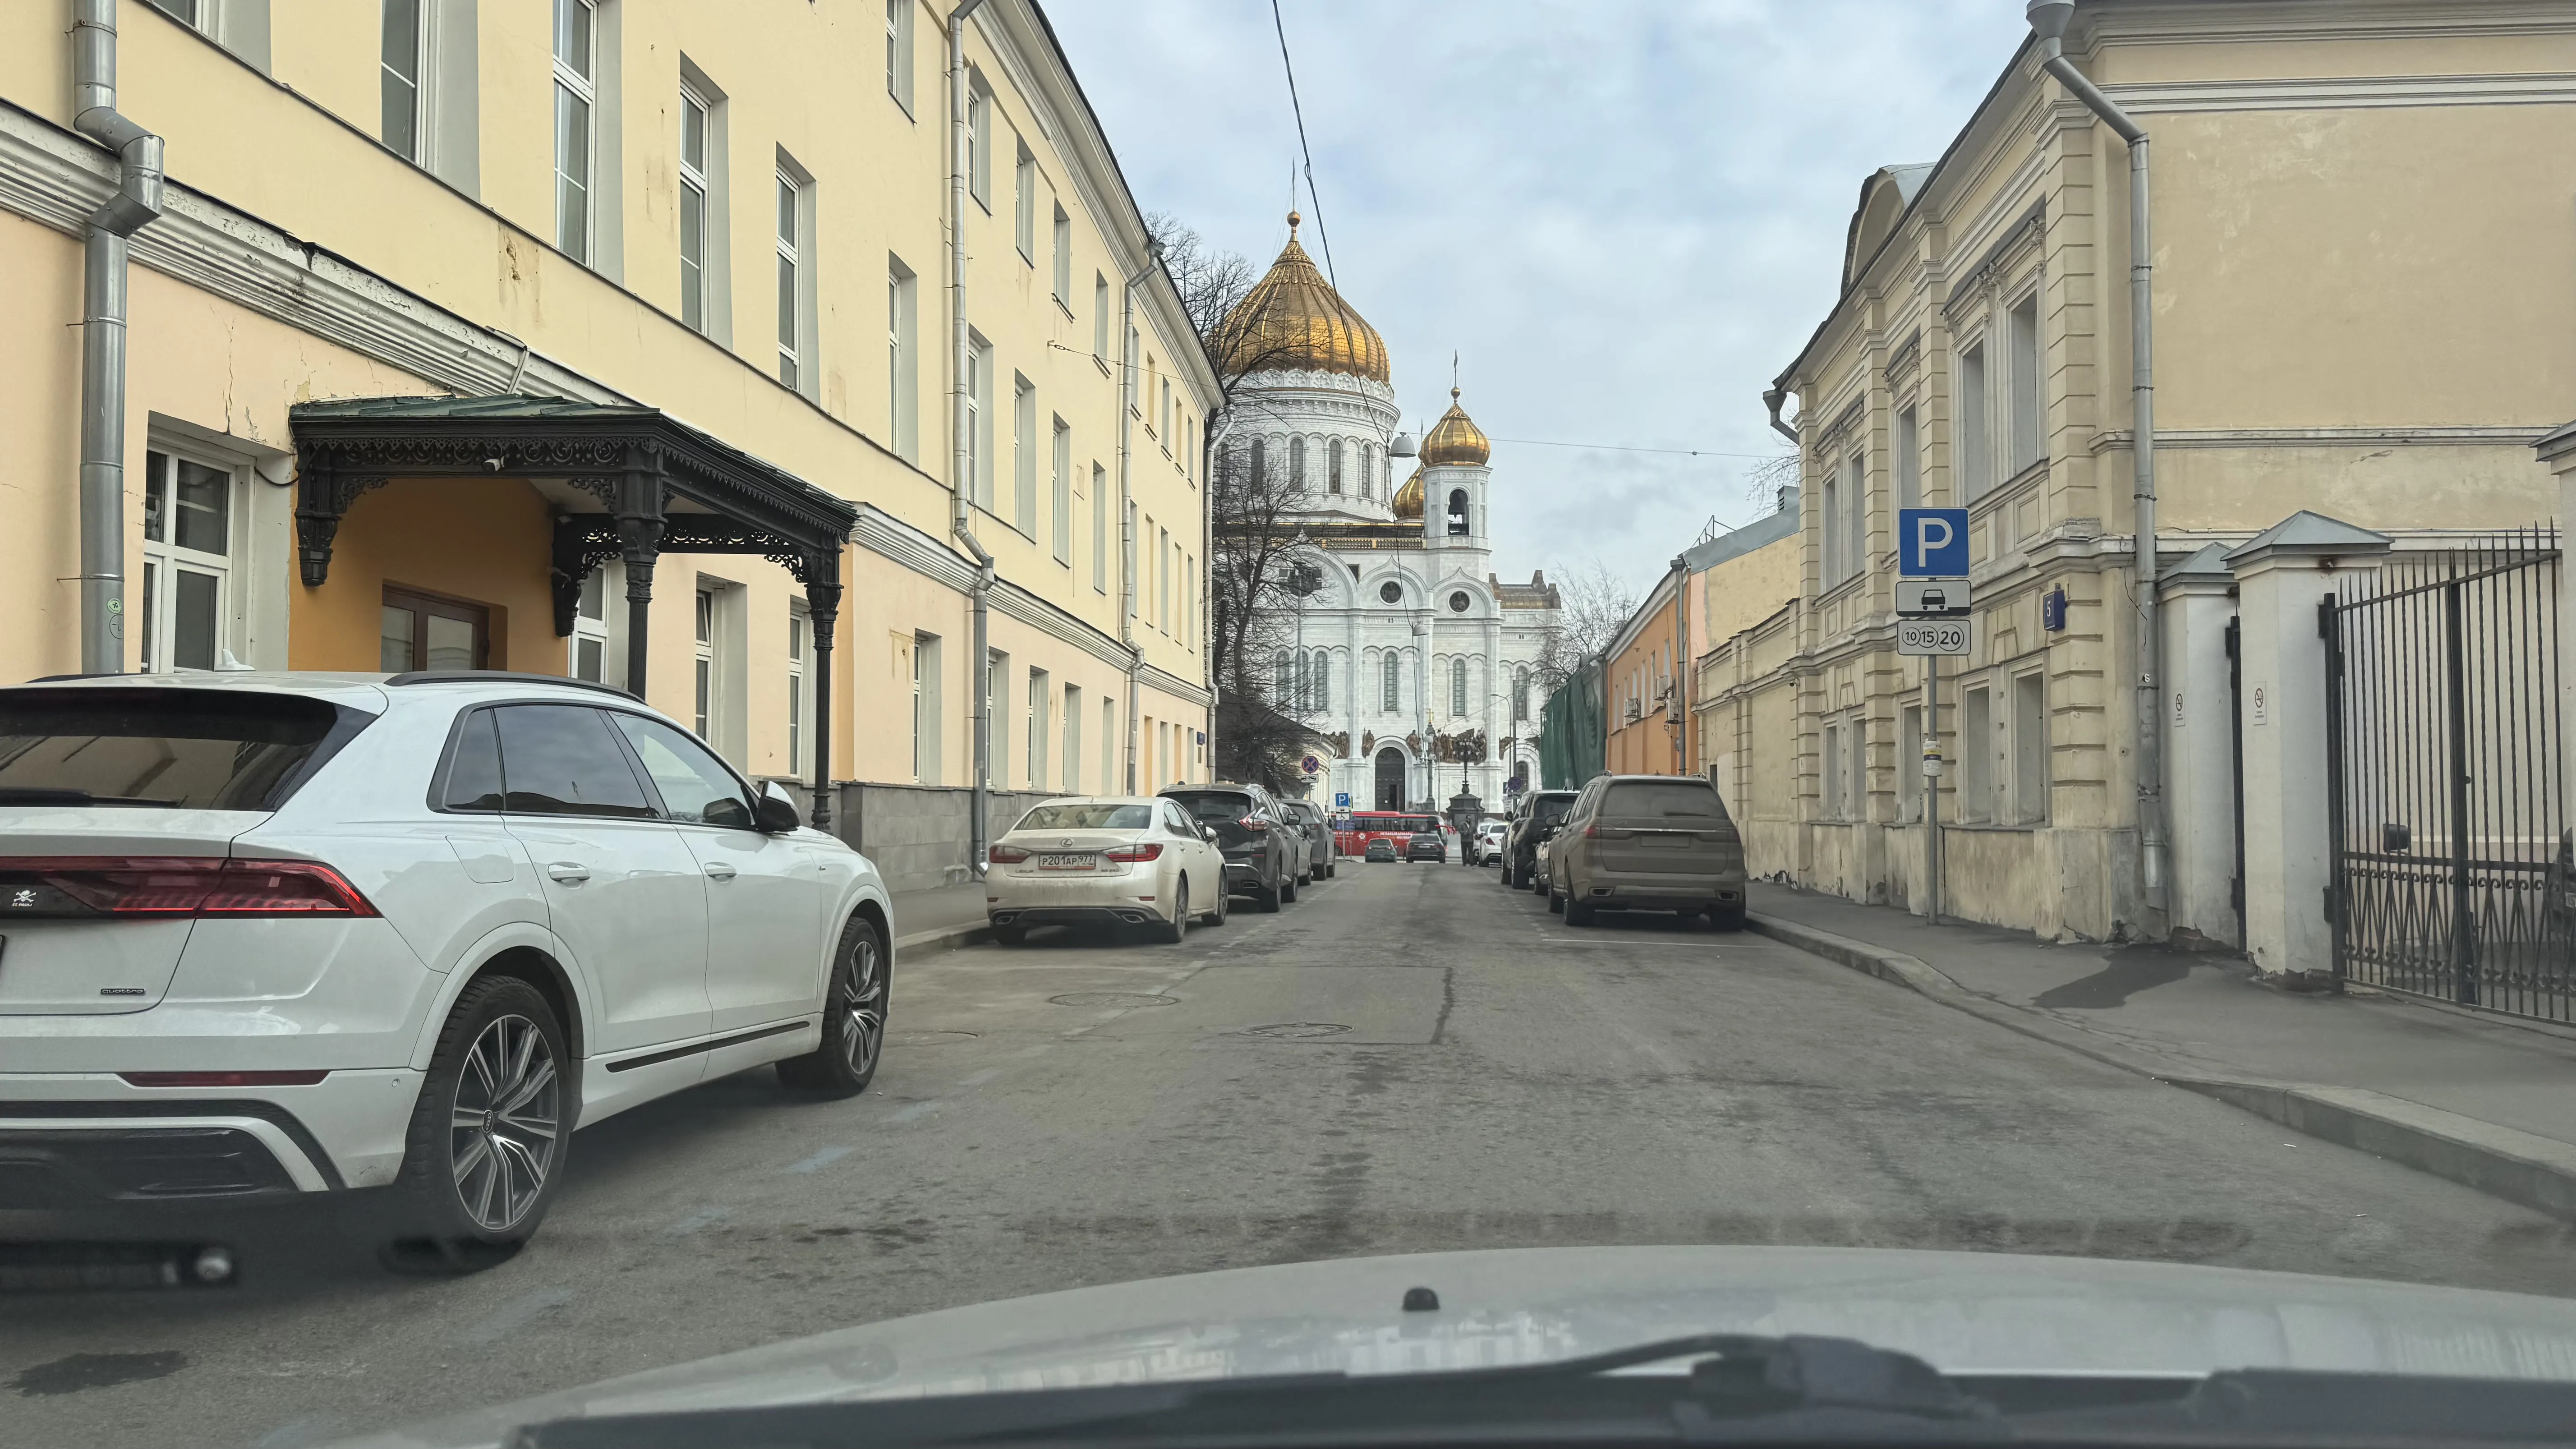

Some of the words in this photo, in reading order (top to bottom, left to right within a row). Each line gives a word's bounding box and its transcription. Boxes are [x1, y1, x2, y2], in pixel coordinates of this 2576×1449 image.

[1918, 517, 1953, 567] P
[2047, 601, 2051, 617] 5
[1905, 631, 1916, 641] 10
[1921, 631, 1934, 643] 15
[1939, 631, 1960, 645] 20
[1339, 795, 1346, 805] P
